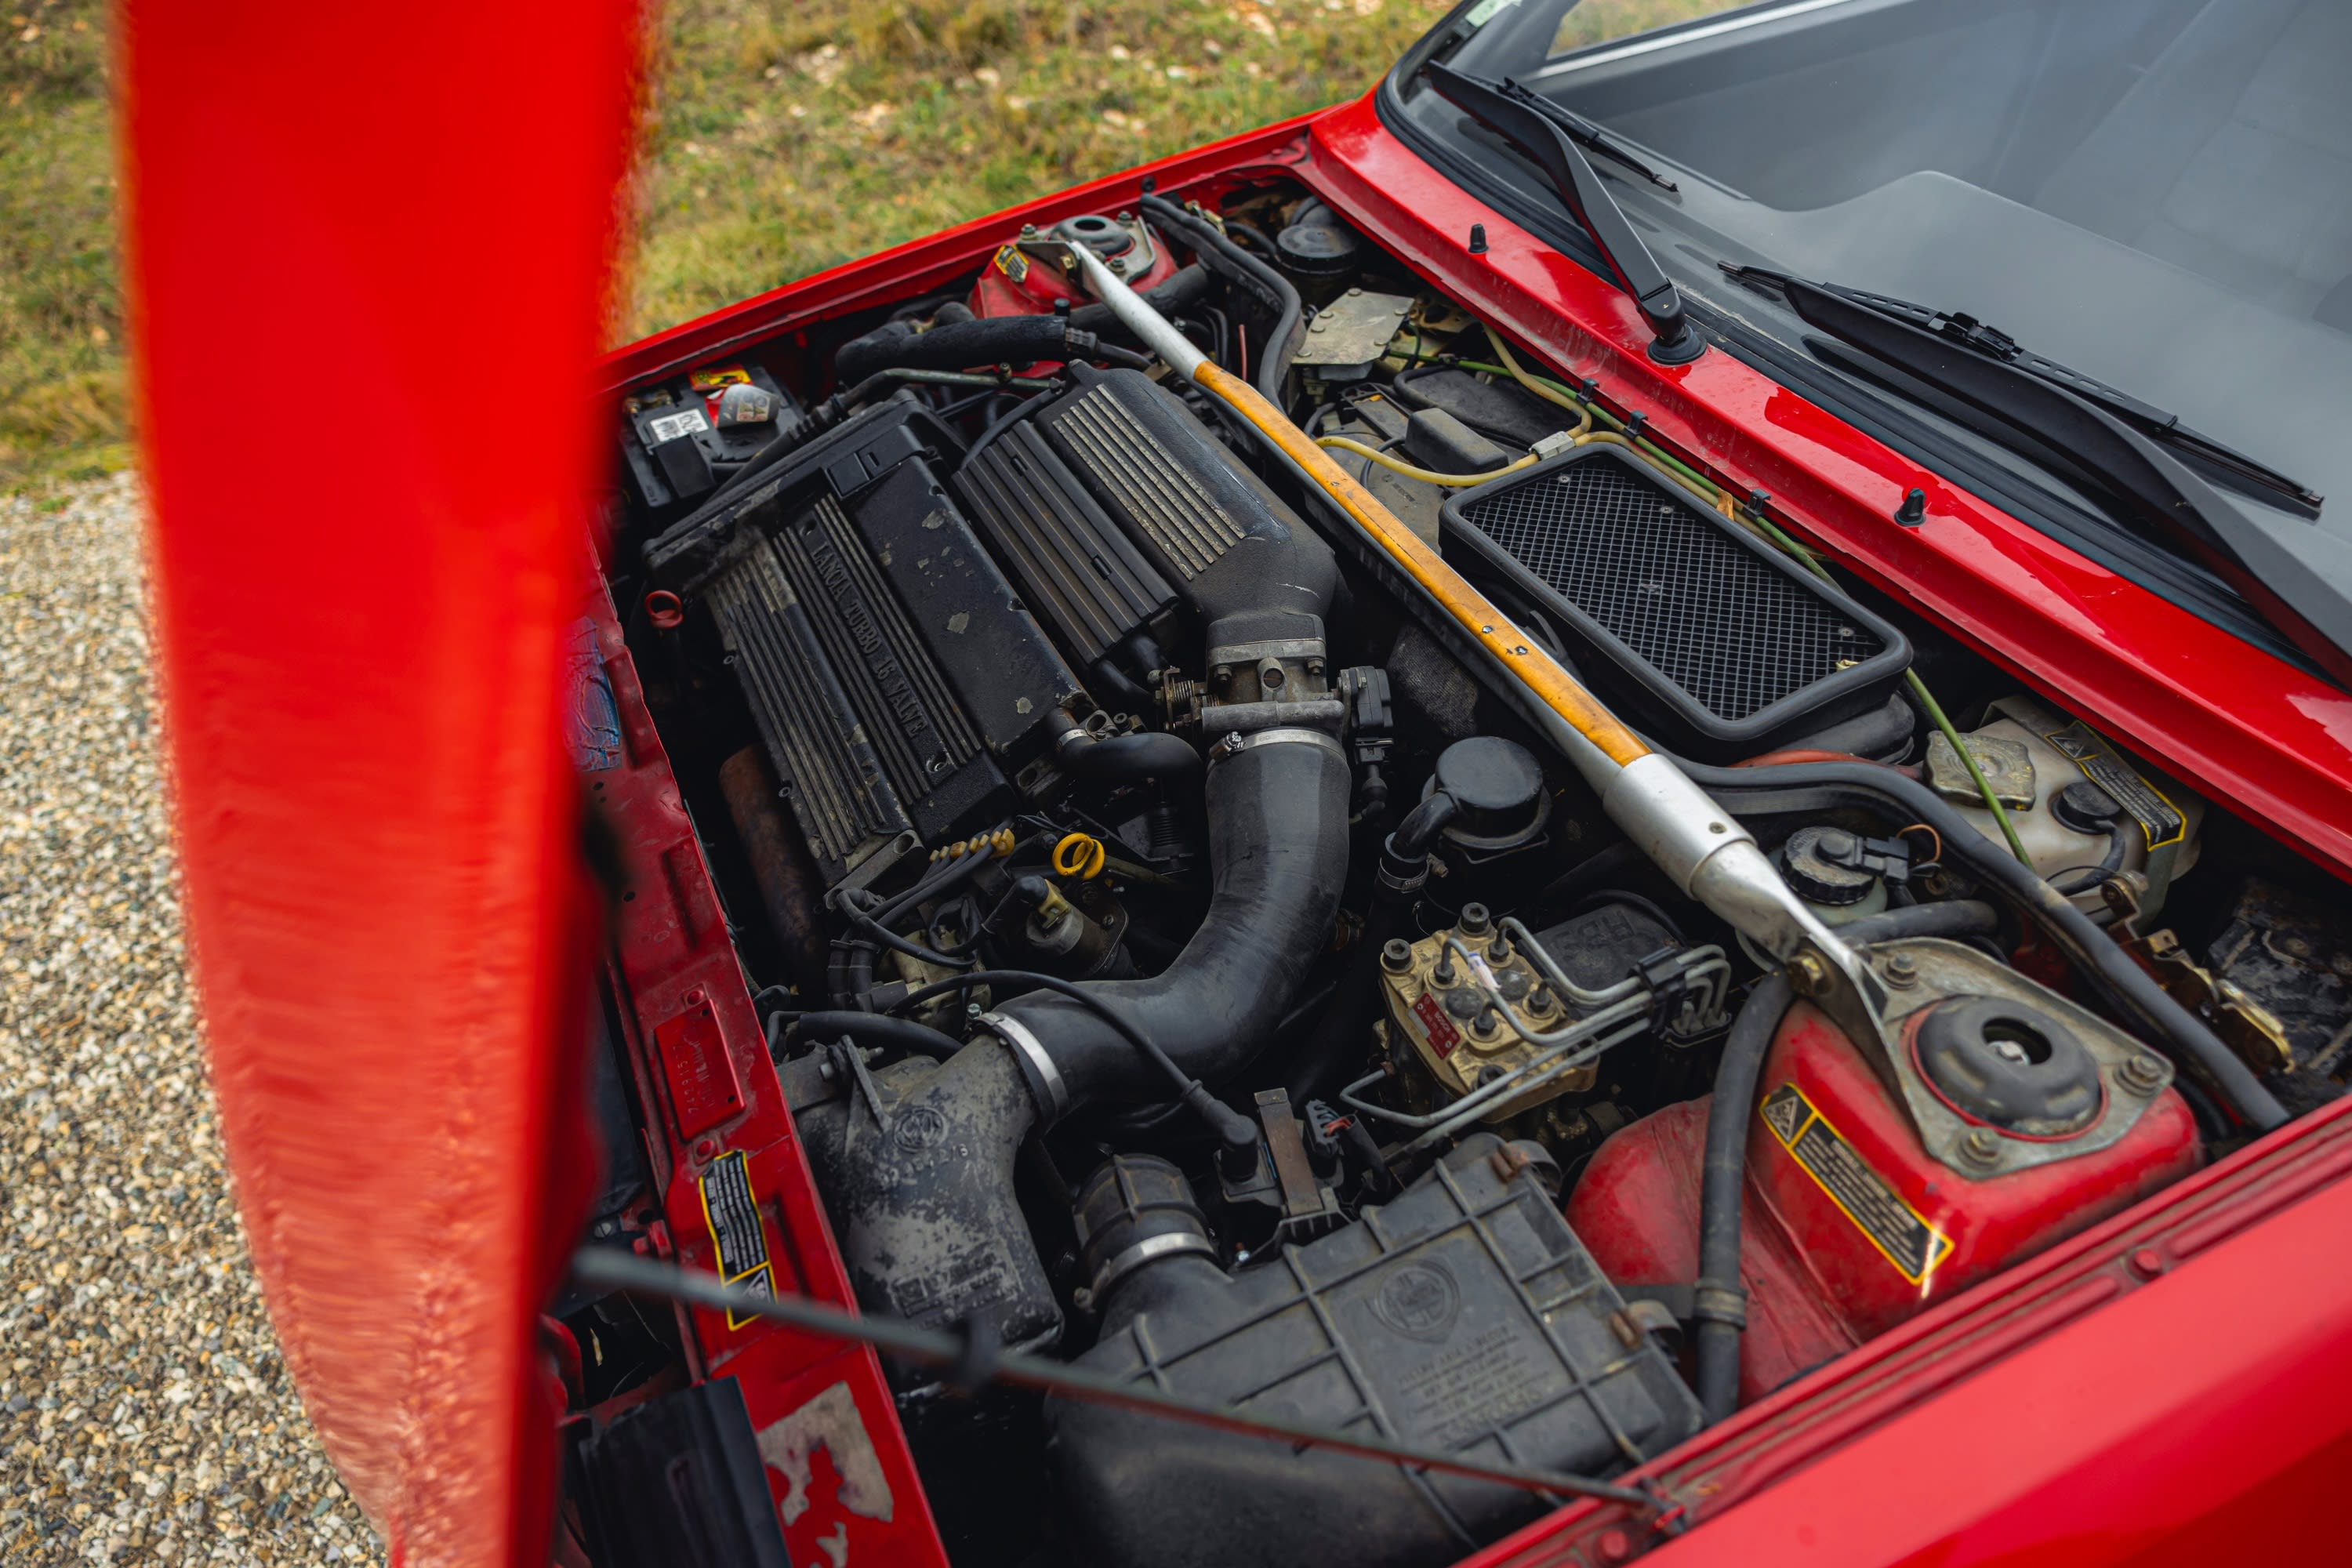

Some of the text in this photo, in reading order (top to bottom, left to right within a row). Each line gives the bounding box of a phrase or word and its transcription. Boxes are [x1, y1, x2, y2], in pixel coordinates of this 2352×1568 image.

[811, 542, 929, 739] LANCIA TURBO 16 VALVE
